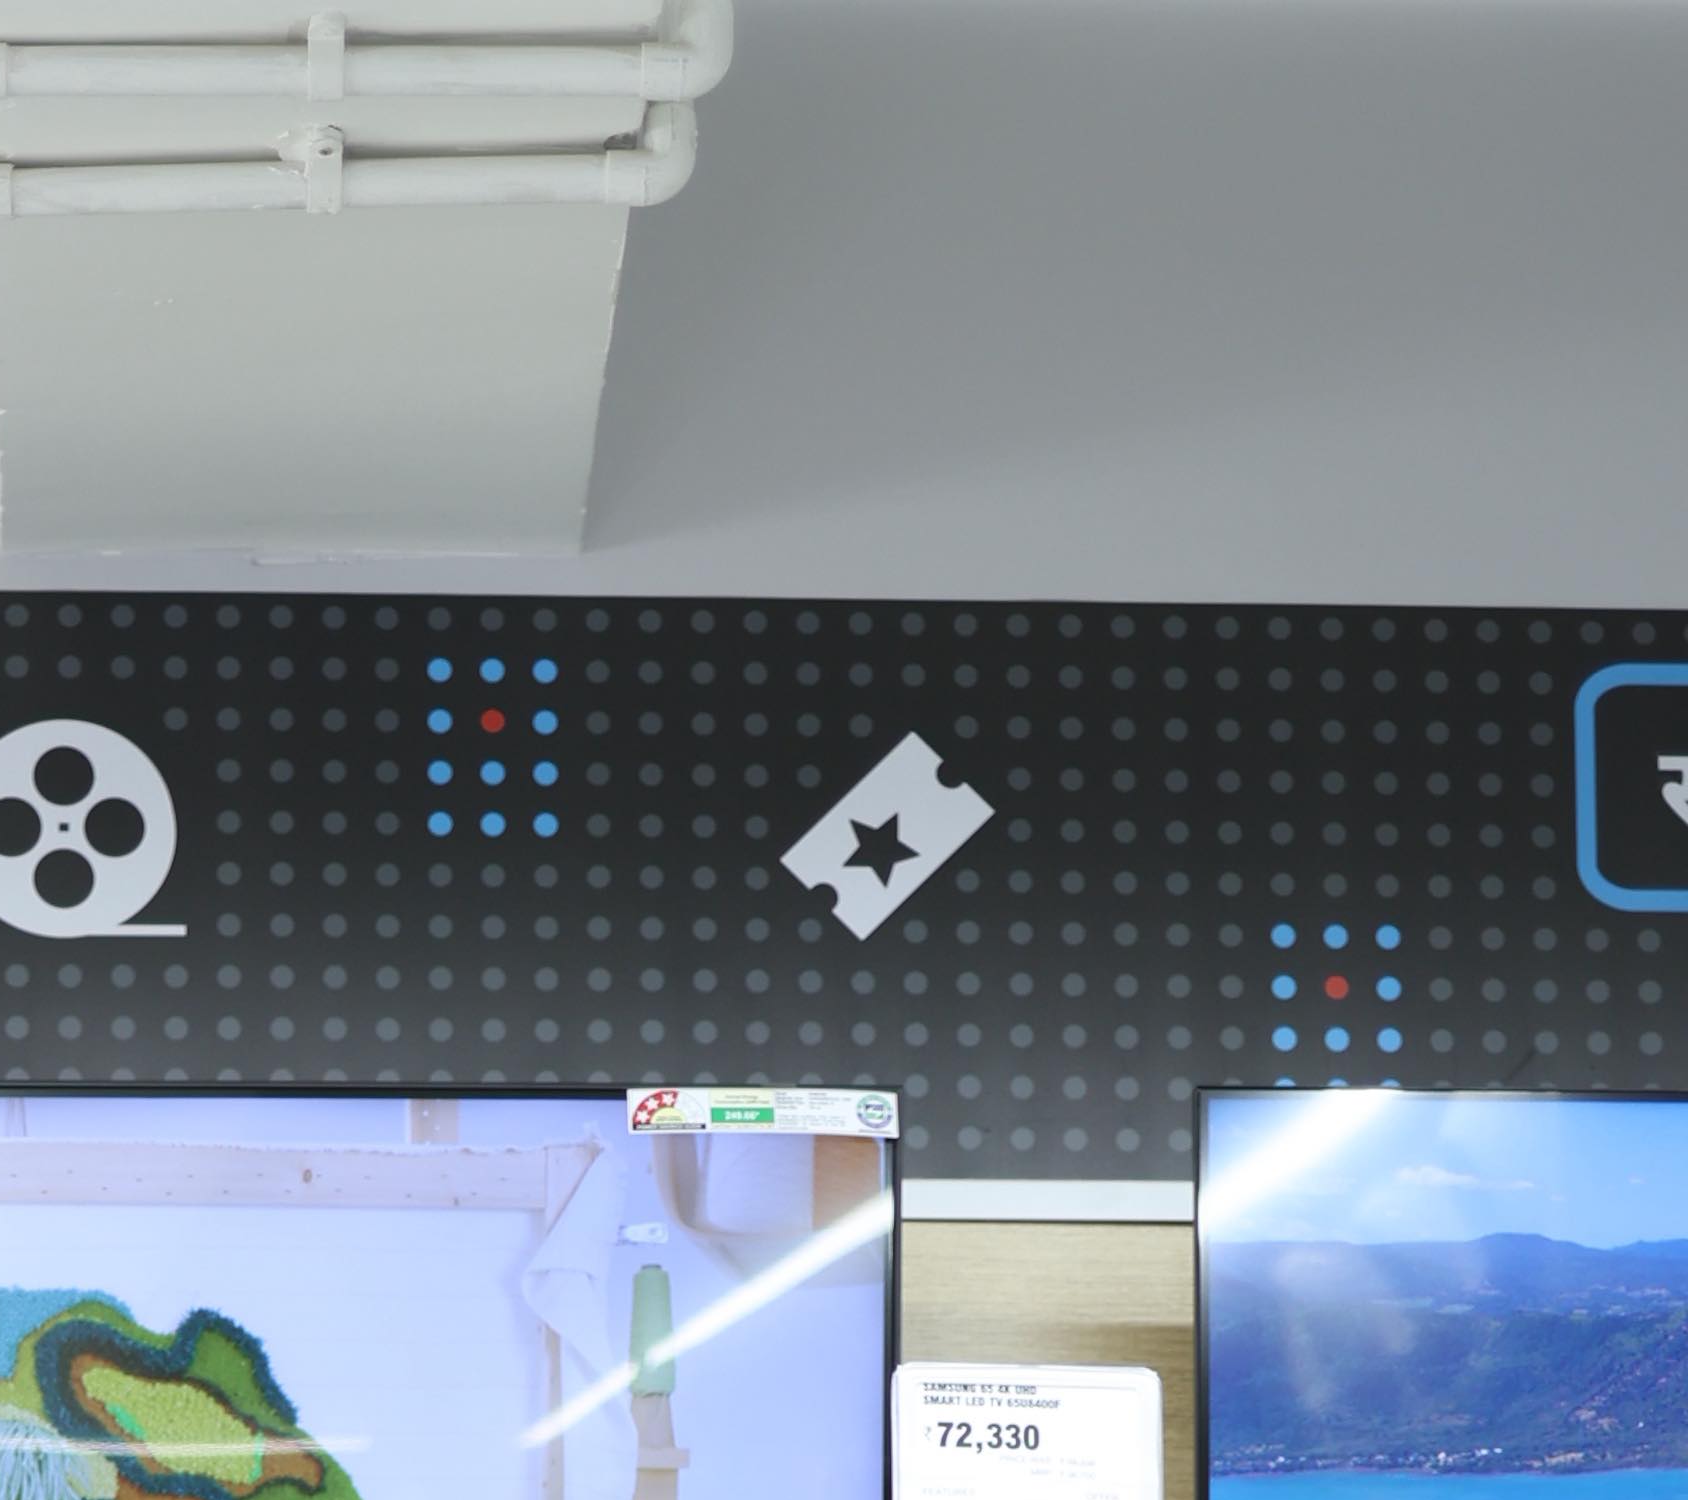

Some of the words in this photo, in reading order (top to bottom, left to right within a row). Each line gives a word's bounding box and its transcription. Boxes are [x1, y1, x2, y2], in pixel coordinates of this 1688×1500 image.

[923, 1382, 977, 1393] SAMSUNG
[923, 1395, 962, 1406] SMART
[965, 1396, 986, 1407] LED
[988, 1397, 1004, 1407] TV
